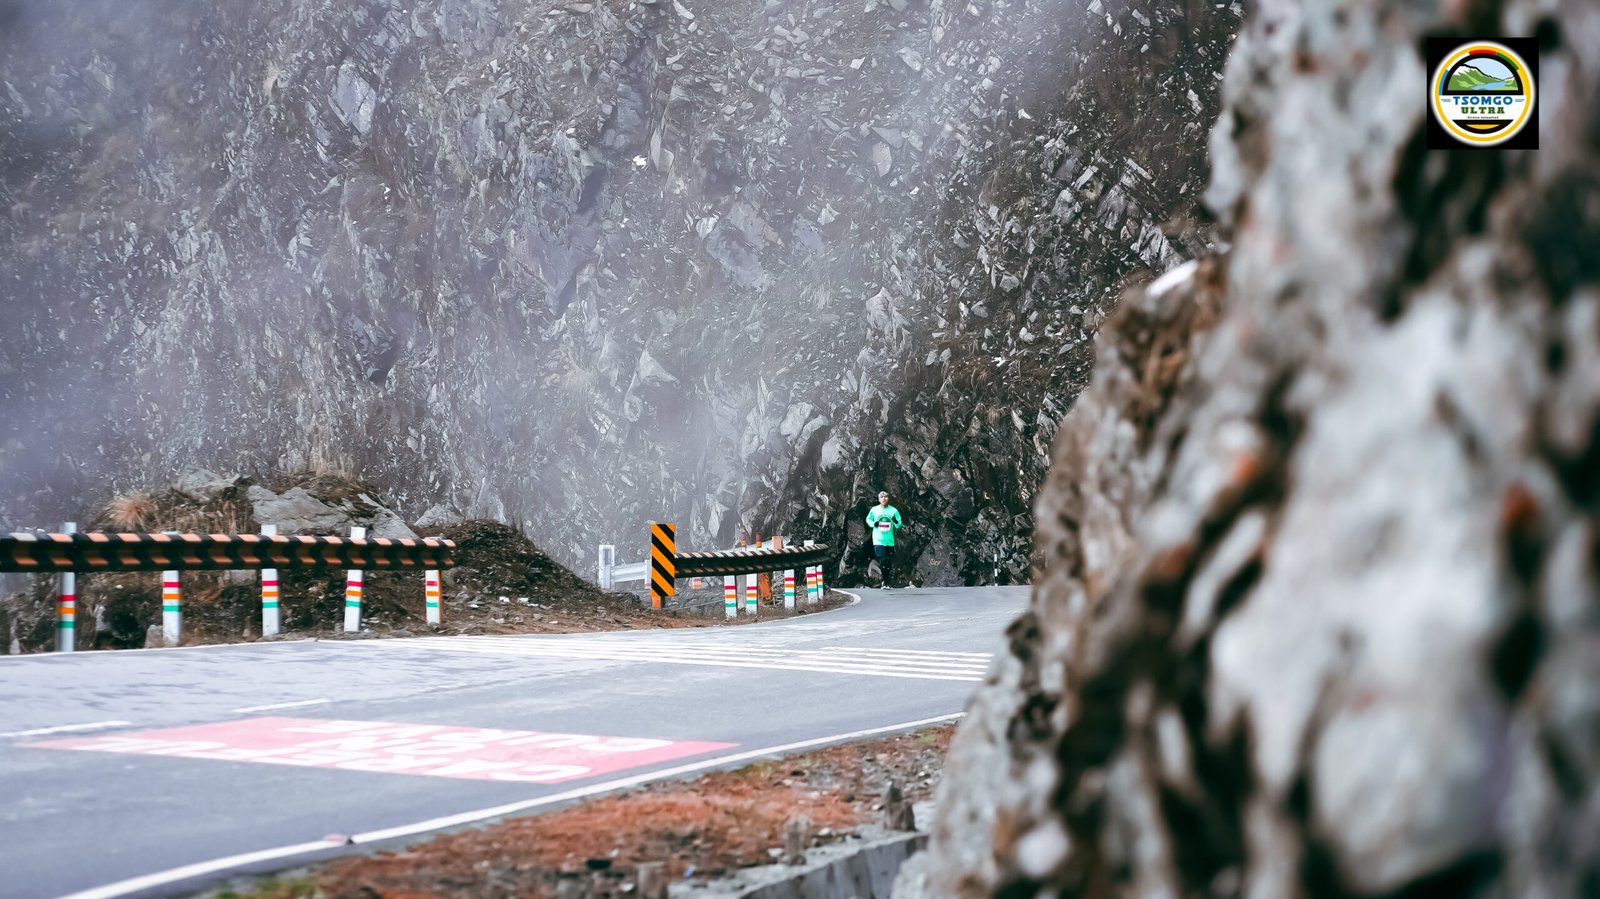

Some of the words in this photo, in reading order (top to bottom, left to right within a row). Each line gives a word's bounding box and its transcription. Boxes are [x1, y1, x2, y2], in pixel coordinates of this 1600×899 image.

[276, 720, 674, 752] CURVE
[296, 736, 487, 754] ON
[71, 736, 592, 781] CAREFUL
